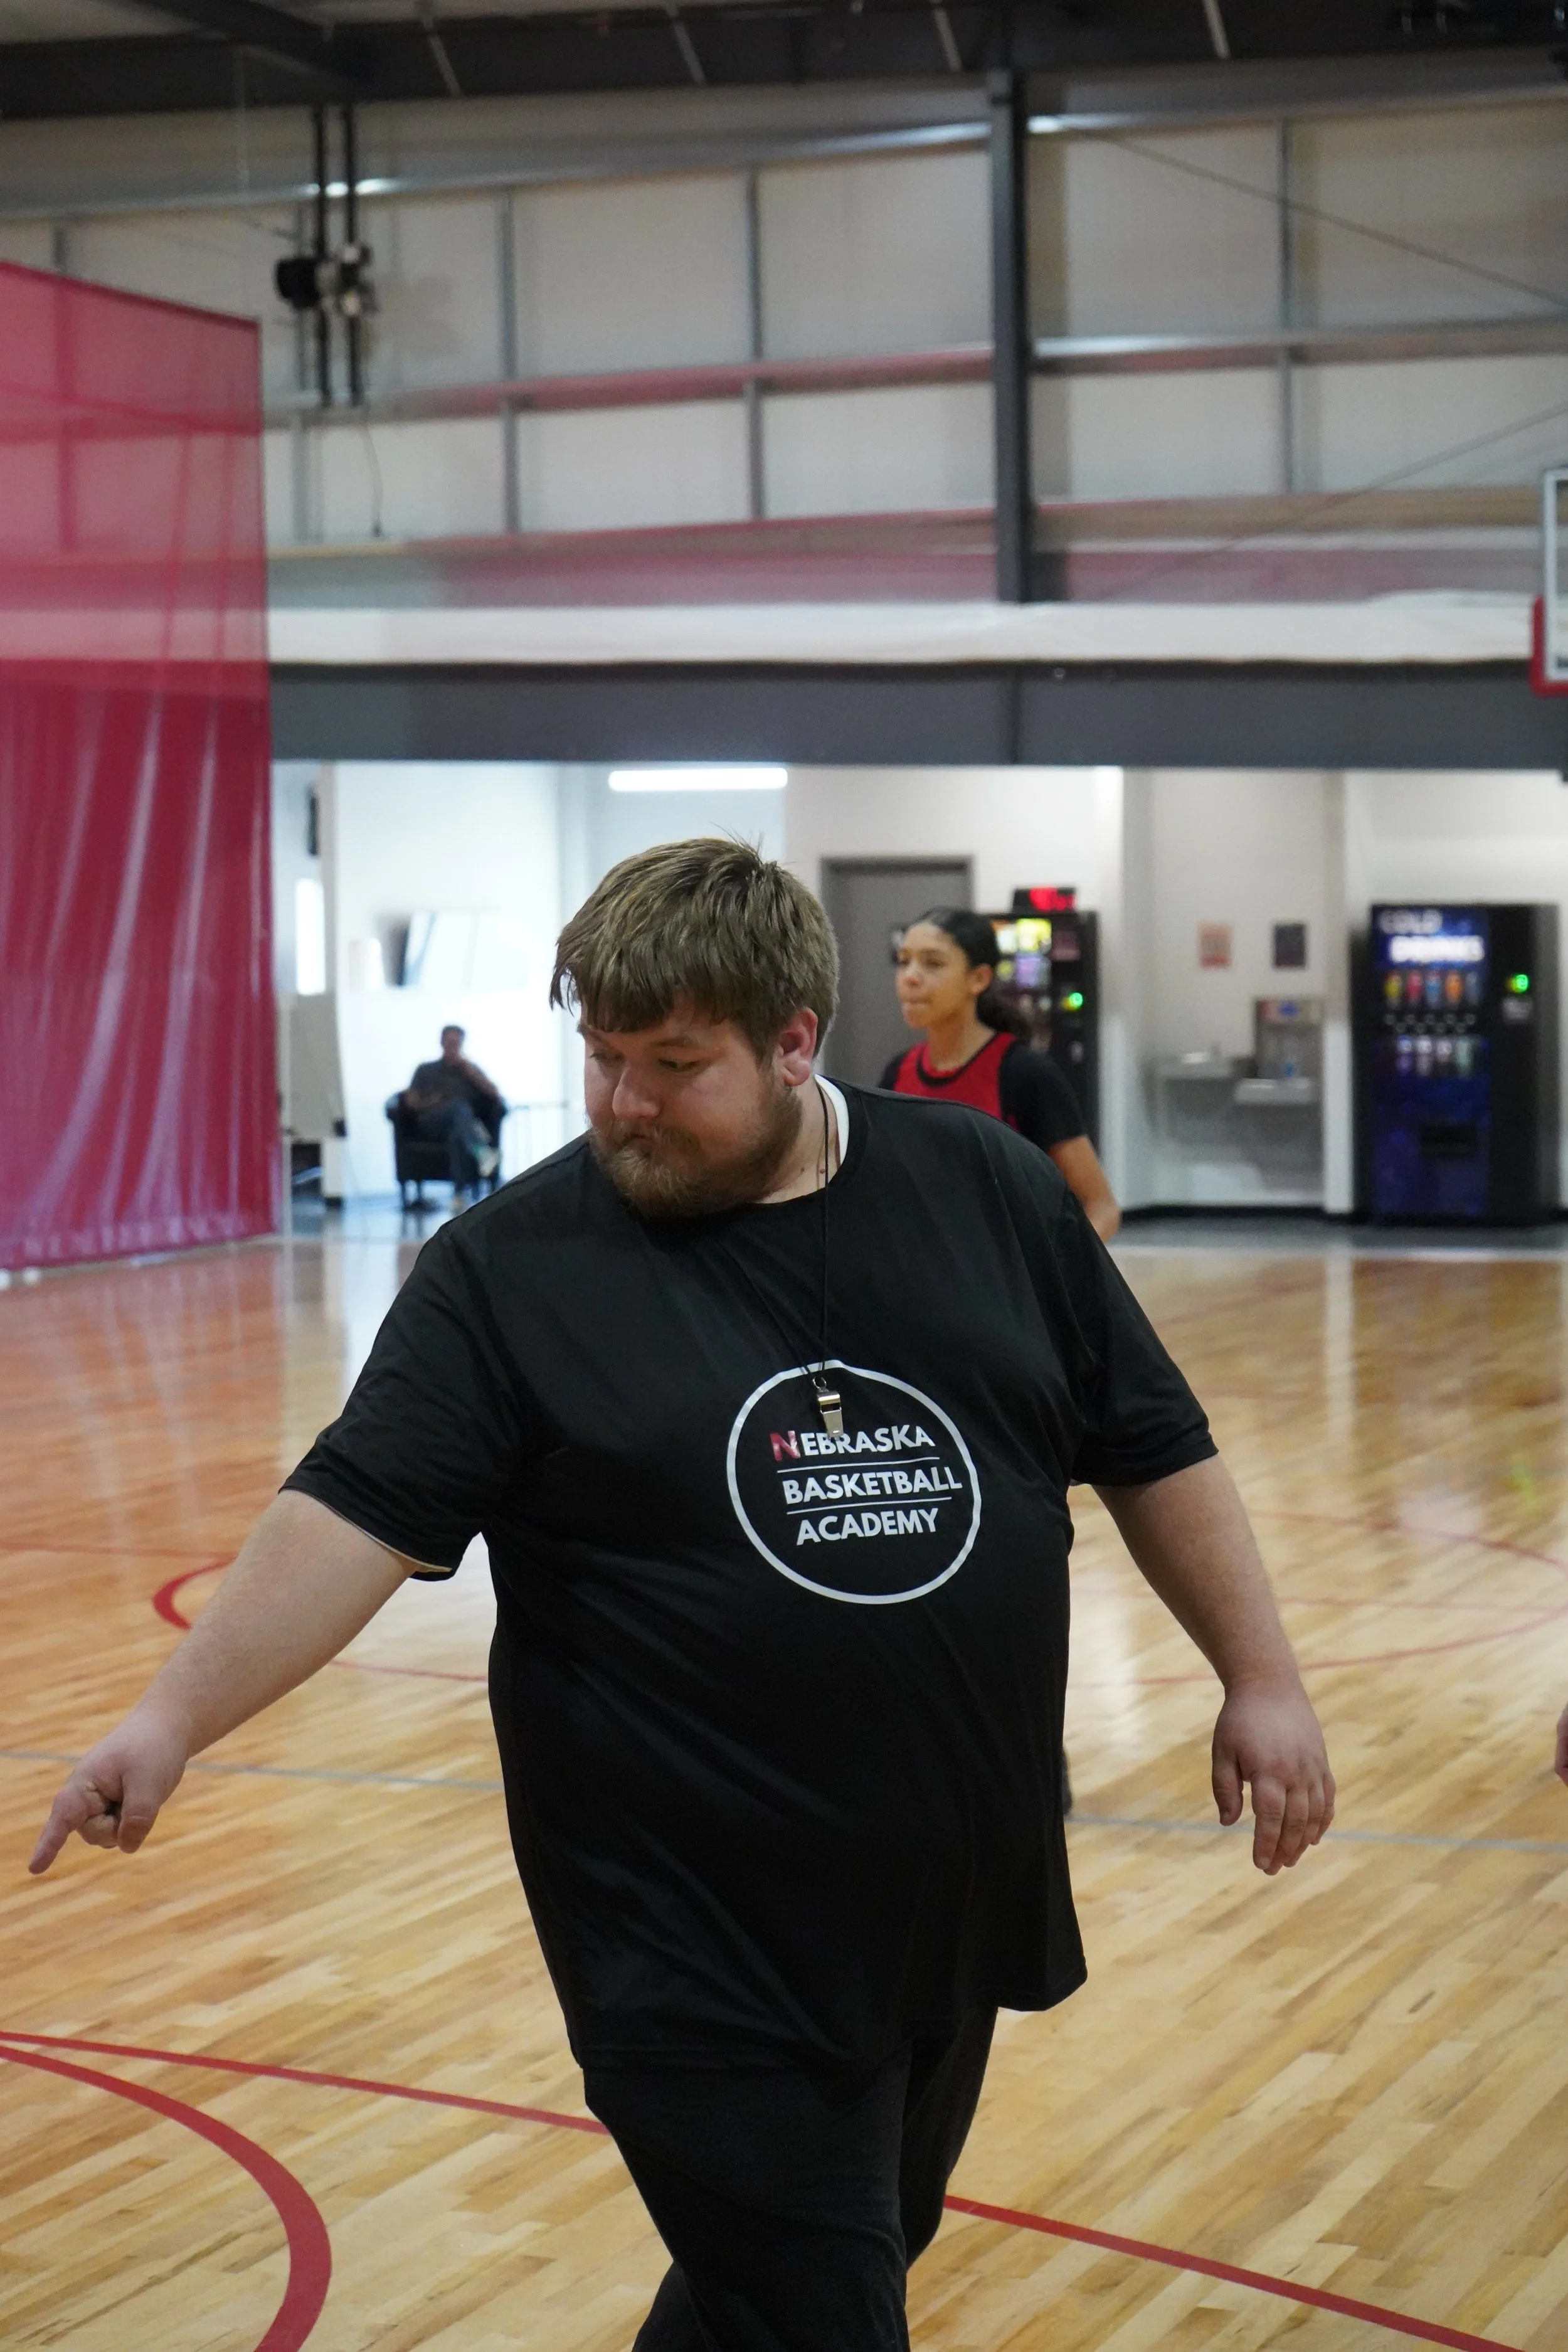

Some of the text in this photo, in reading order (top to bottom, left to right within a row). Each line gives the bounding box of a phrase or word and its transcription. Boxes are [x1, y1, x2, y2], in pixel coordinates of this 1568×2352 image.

[770, 1424, 936, 1461] NEBRASKA
[782, 1466, 963, 1505] BASKETBALL
[796, 1508, 938, 1546] ACADEMY
